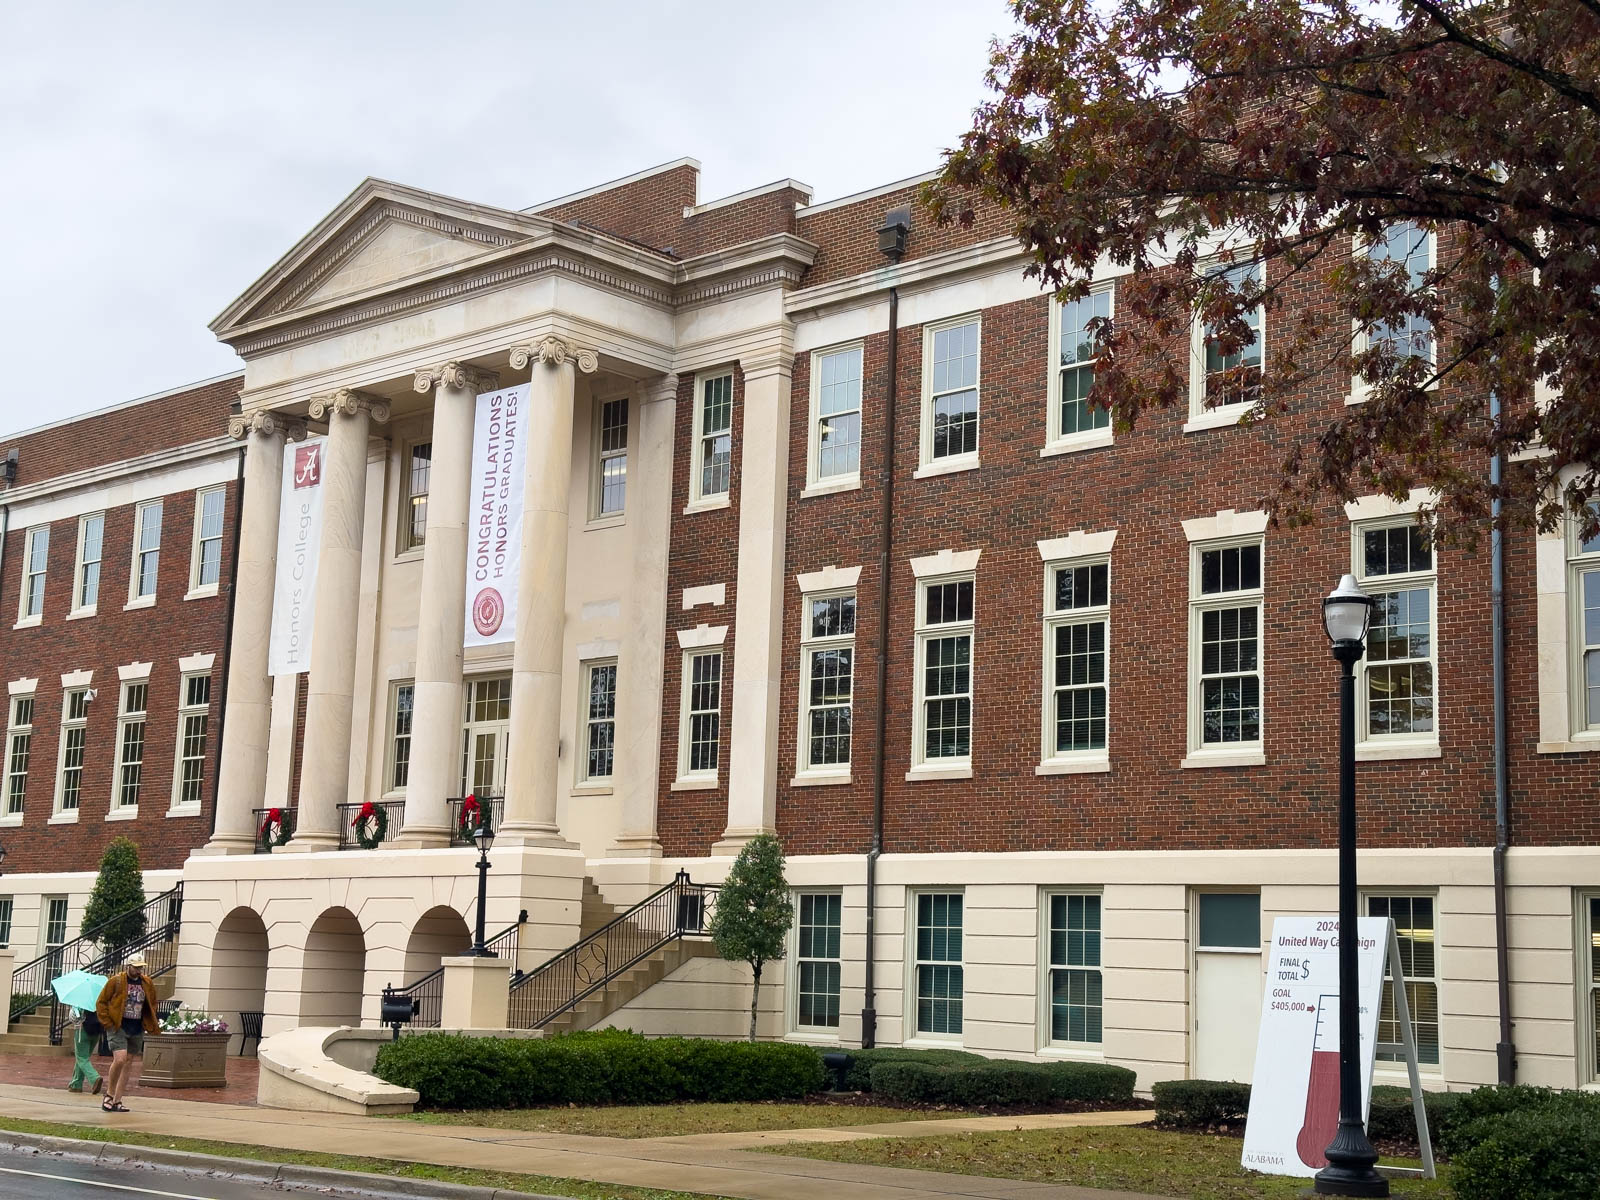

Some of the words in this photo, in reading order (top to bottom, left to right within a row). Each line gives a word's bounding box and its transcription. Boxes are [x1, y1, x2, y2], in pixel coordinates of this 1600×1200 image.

[476, 395, 502, 581] CONGRATULATIONS
[493, 504, 507, 578] HONORS
[500, 391, 517, 499] GRADUATES!
[293, 503, 311, 580] College
[287, 589, 301, 663] Honors
[1317, 921, 1340, 931] 2024
[1278, 936, 1307, 947] United
[1309, 937, 1328, 950] Way
[1279, 957, 1300, 967] FINAL
[1278, 971, 1299, 980] TOTAL
[1301, 959, 1310, 980] $
[1272, 988, 1291, 998] GOAL
[1271, 1001, 1305, 1012] $405,000
[1245, 1154, 1284, 1165] ALABAMA
